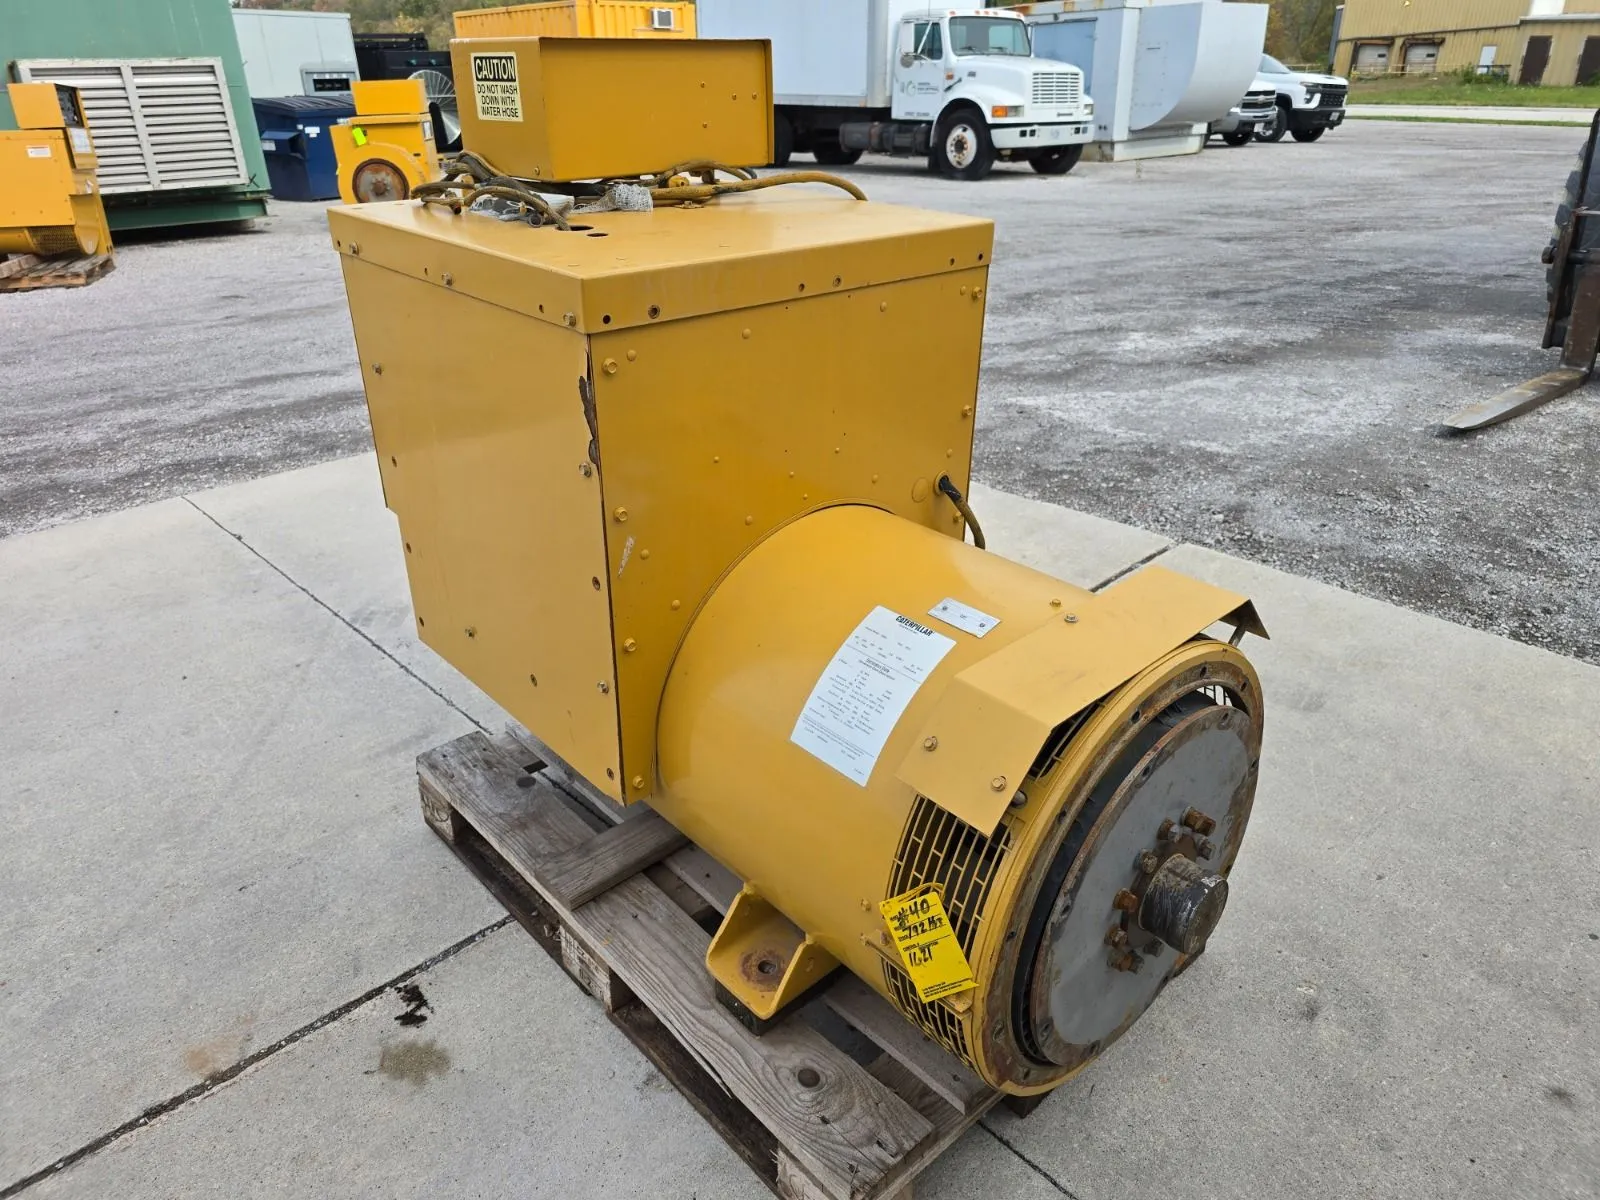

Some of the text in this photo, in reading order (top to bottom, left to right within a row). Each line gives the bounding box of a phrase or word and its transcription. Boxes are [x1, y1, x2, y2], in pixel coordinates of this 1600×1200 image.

[475, 58, 516, 80] CAUTION
[477, 84, 518, 95] DO NOT WASH
[481, 95, 516, 106] DOWN WITH
[481, 106, 519, 118] WATER HOSE
[895, 615, 934, 637] CATERPILLAR
